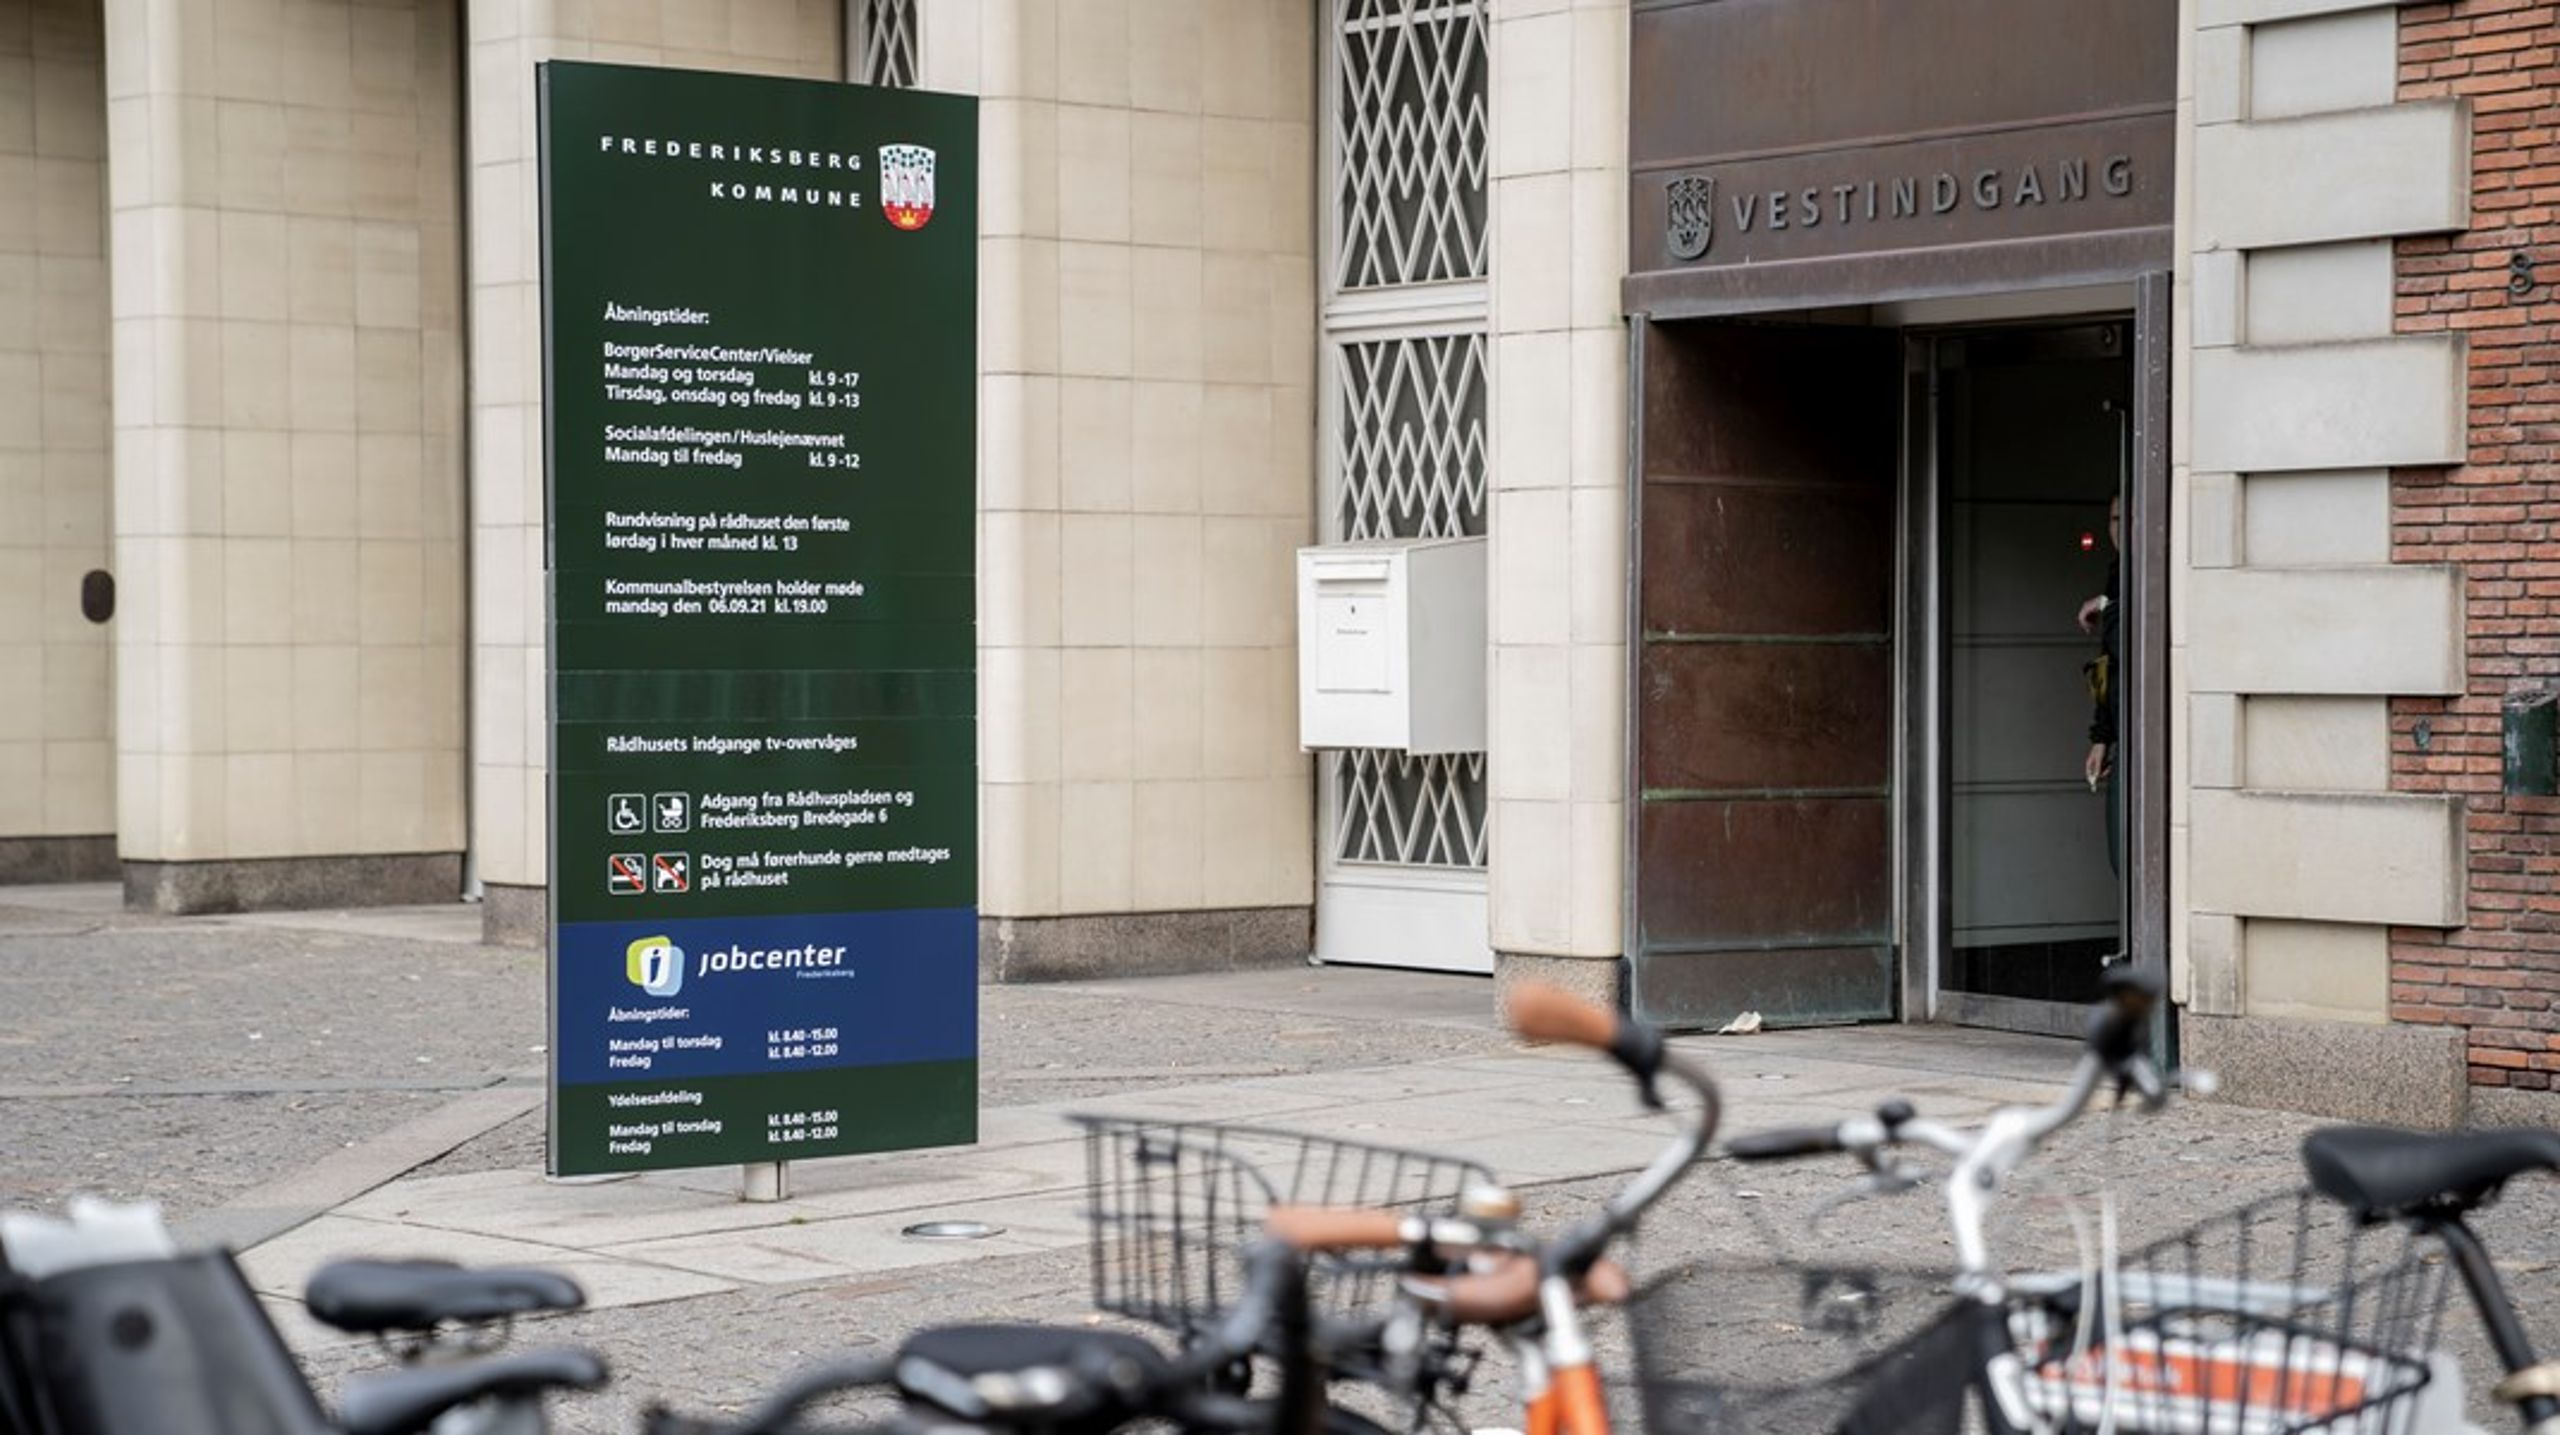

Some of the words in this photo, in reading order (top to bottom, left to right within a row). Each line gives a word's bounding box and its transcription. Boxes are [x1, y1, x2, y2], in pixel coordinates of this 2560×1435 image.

[602, 137, 861, 170] FREDERIKSBERG
[712, 183, 861, 207] KOMMUNE
[1732, 155, 2135, 232] VESTINDGANG
[605, 302, 709, 325] Åbningstider:
[605, 342, 813, 364] BorgerServiceCenter/Vielser
[605, 364, 668, 384] Mandag
[672, 369, 692, 384] og
[697, 368, 754, 386] torsdag
[809, 371, 825, 386] kl.
[606, 385, 667, 404] Tirsdag,
[671, 387, 726, 406] onsdag
[730, 392, 749, 406] og
[753, 389, 801, 409] fredag
[809, 392, 825, 406] kl.
[605, 448, 668, 467] Mandag
[674, 448, 689, 464] til
[693, 449, 742, 468] fredag
[809, 453, 825, 468] kl.
[606, 513, 695, 532] Rundvisning
[699, 513, 717, 532] på
[720, 514, 781, 531] rådhuset
[783, 517, 808, 531] den
[811, 517, 850, 531] første
[606, 534, 656, 553] lørdag
[661, 534, 666, 549] i
[671, 534, 703, 550] hver
[708, 535, 758, 550] måned
[762, 535, 778, 551] kl.
[783, 536, 797, 551] 13
[606, 579, 772, 601] Kommunalbestyrelsen
[776, 580, 821, 596] holder
[825, 581, 863, 596] møde
[606, 599, 668, 618] mandag
[673, 599, 702, 614] den
[709, 600, 766, 614] 06.09.21
[607, 735, 688, 753] Rådhusets
[693, 736, 761, 754] indgange
[765, 733, 856, 751] tv-overvåges
[701, 793, 757, 811] Adgang
[762, 793, 783, 806] fra
[786, 789, 891, 809] Rådhuspladsen
[896, 792, 913, 806] og
[701, 811, 798, 830] Frederiksberg
[803, 810, 874, 827] Bredegade
[877, 809, 887, 824] 6
[701, 854, 732, 872] Dog
[737, 852, 759, 868] må
[764, 850, 841, 867] førerhunde
[846, 851, 883, 866] gerne
[887, 846, 949, 862] medtages
[701, 872, 720, 890] på
[725, 870, 788, 887] rådhuset
[699, 945, 846, 977] jobcenter
[608, 1006, 689, 1023] Åbningstider:
[610, 1037, 658, 1053] Mandag
[662, 1036, 675, 1049] til
[676, 1034, 722, 1050] torsdag
[768, 1031, 780, 1044] kl.
[610, 1054, 651, 1069] Fredag
[768, 1047, 780, 1059] kl.
[609, 1090, 702, 1107] Ydelsesafdeling
[610, 1122, 658, 1138] Mandag
[662, 1121, 675, 1134] til
[676, 1119, 722, 1135] torsdag
[768, 1115, 780, 1127] kl.
[768, 1131, 780, 1143] kl.
[610, 1140, 651, 1155] Fredag
